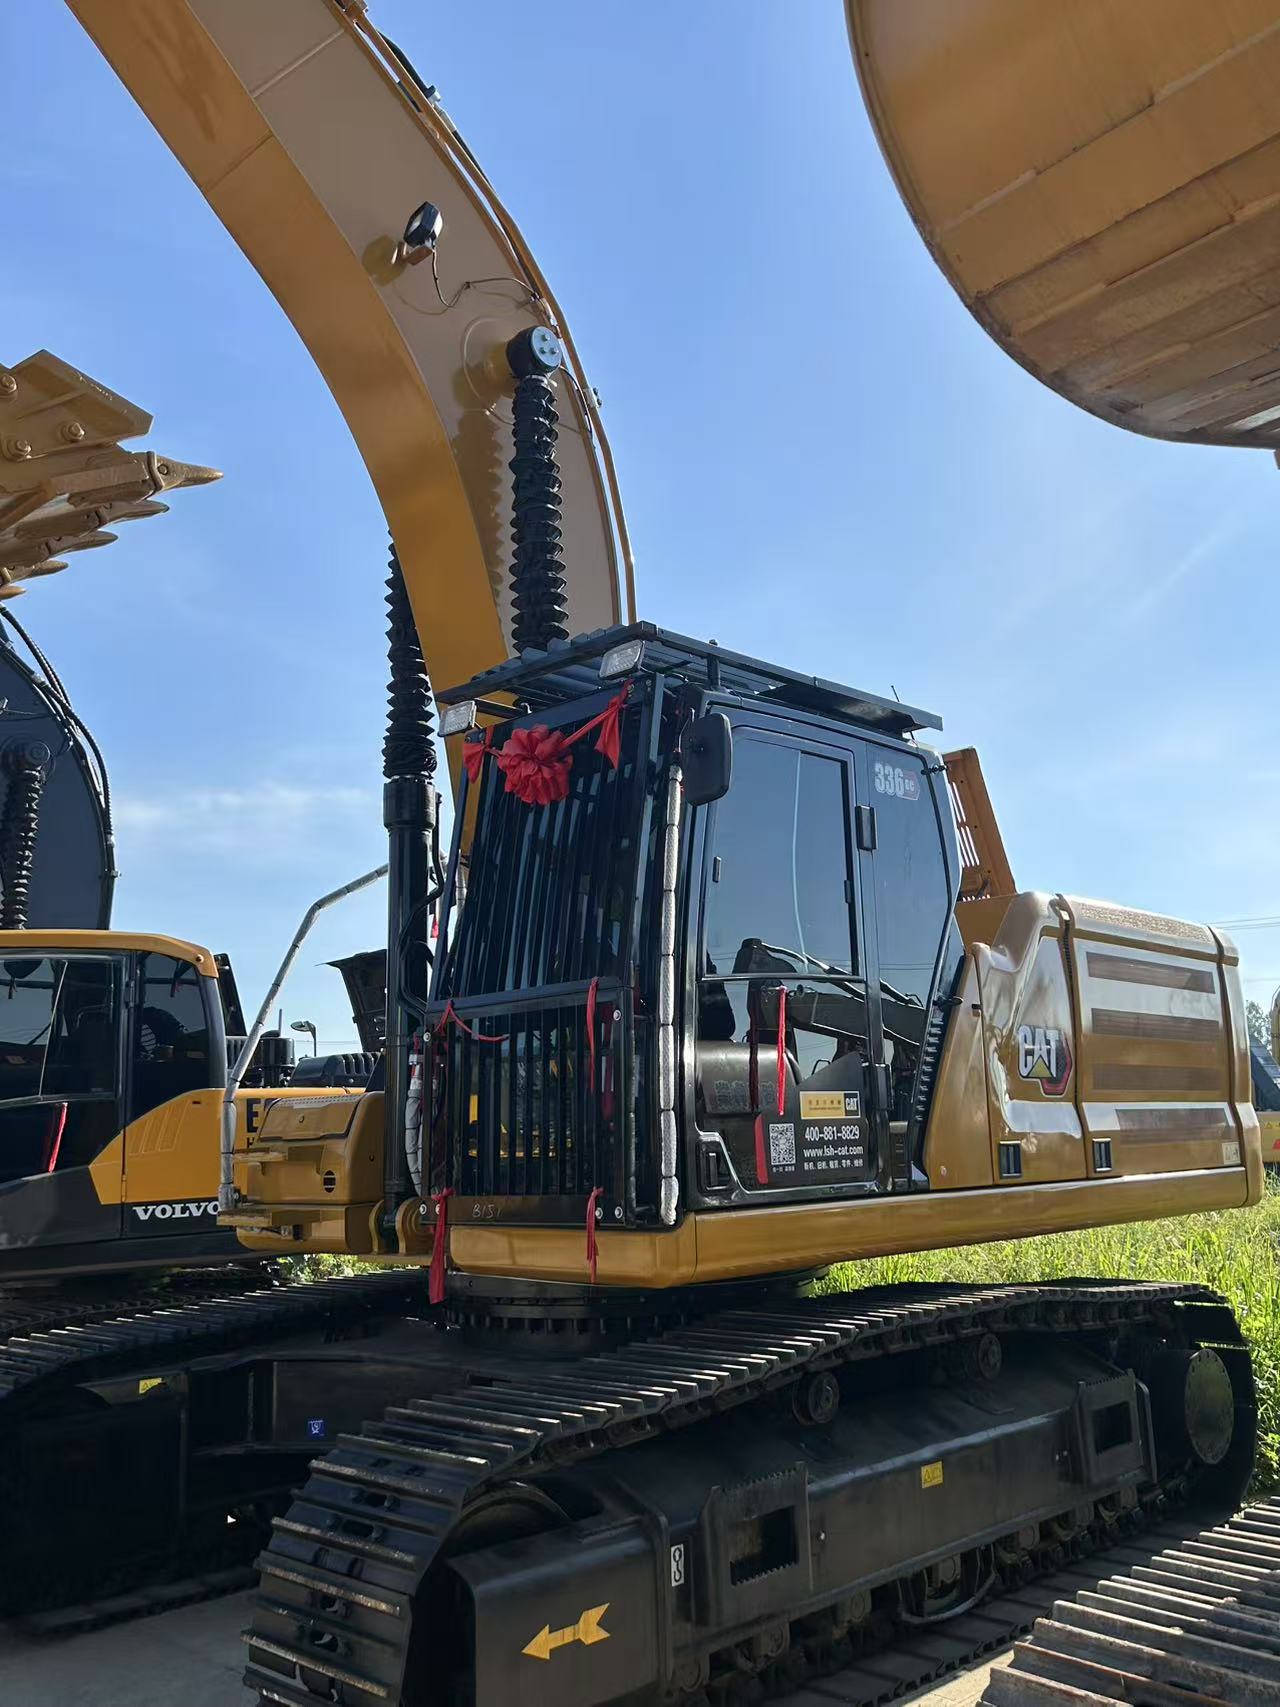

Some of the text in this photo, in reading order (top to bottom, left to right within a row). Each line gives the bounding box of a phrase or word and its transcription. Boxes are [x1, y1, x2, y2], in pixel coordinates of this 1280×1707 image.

[875, 762, 904, 796] 336
[1018, 1025, 1059, 1077] CAT
[846, 1098, 857, 1111] CAT
[805, 1125, 860, 1141] 400-881-8829
[803, 1145, 864, 1157] www.lsh-cat.com
[132, 1200, 222, 1220] VOLVO
